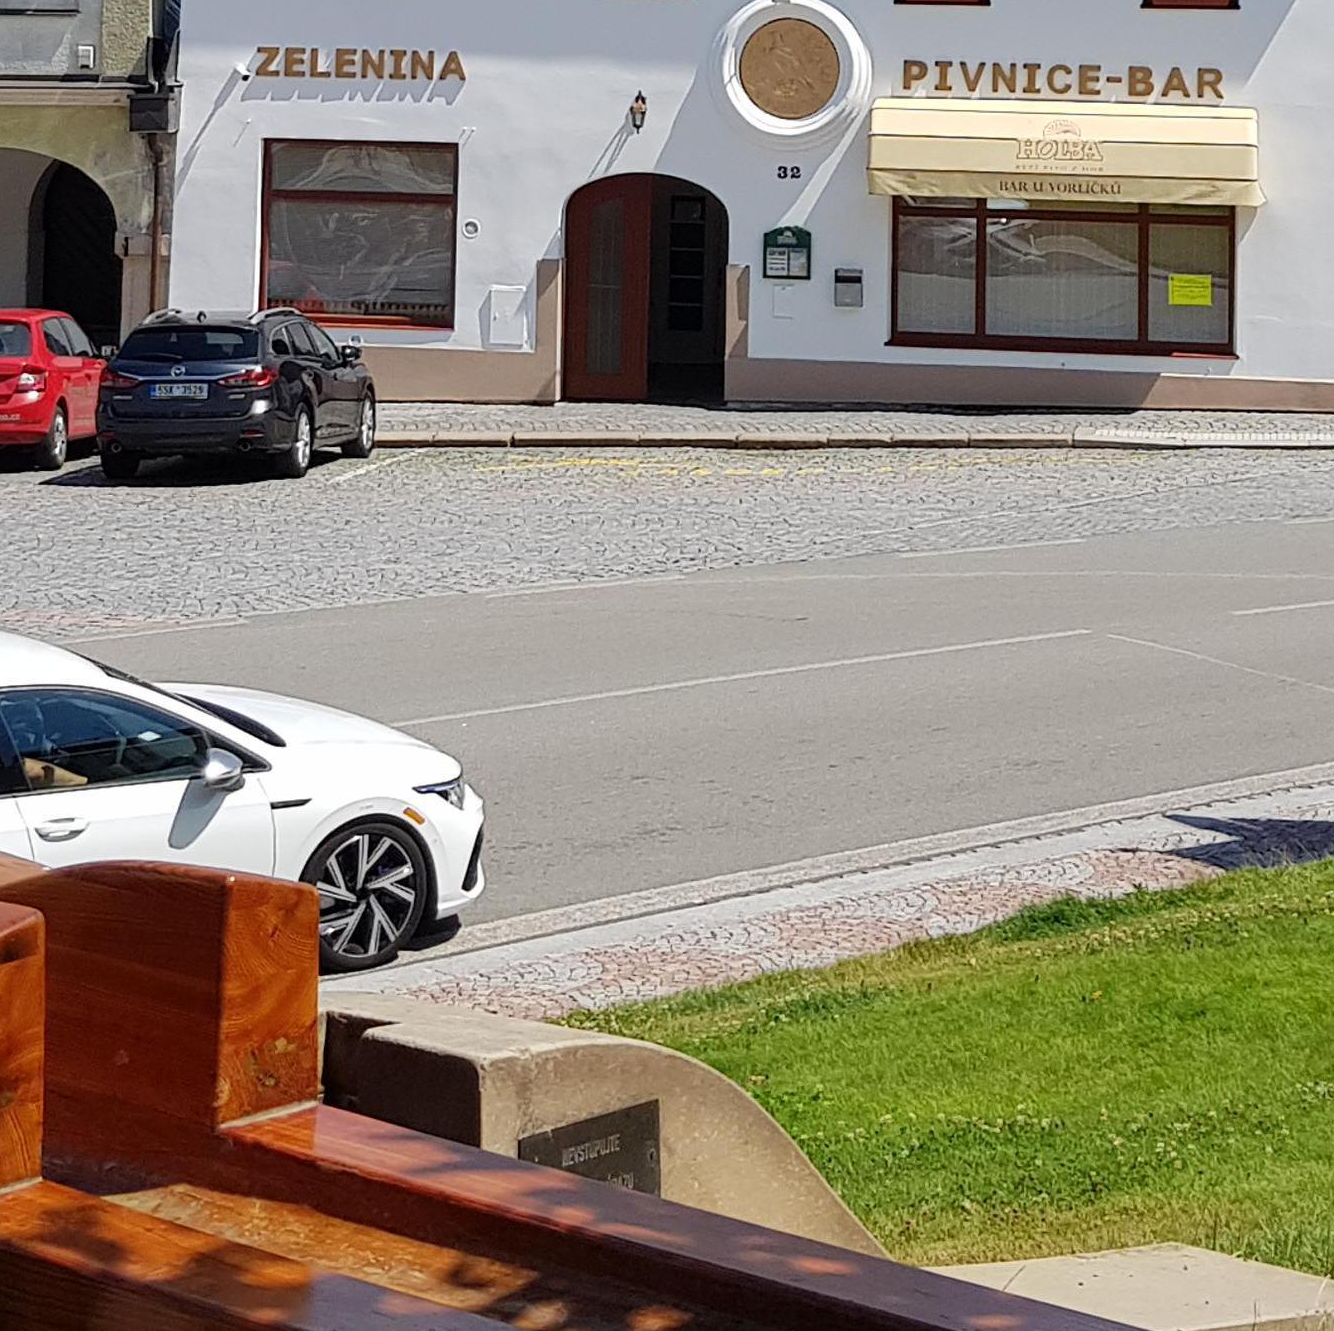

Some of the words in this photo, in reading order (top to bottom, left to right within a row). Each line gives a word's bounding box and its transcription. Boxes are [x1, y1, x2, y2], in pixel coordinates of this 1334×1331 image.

[255, 46, 467, 81] ZELENINA
[902, 59, 1225, 100] PIVNICE-BAR
[1017, 138, 1104, 162] HOLBA
[777, 166, 802, 179] 32
[999, 180, 1028, 192] BAR
[1033, 181, 1044, 192] U
